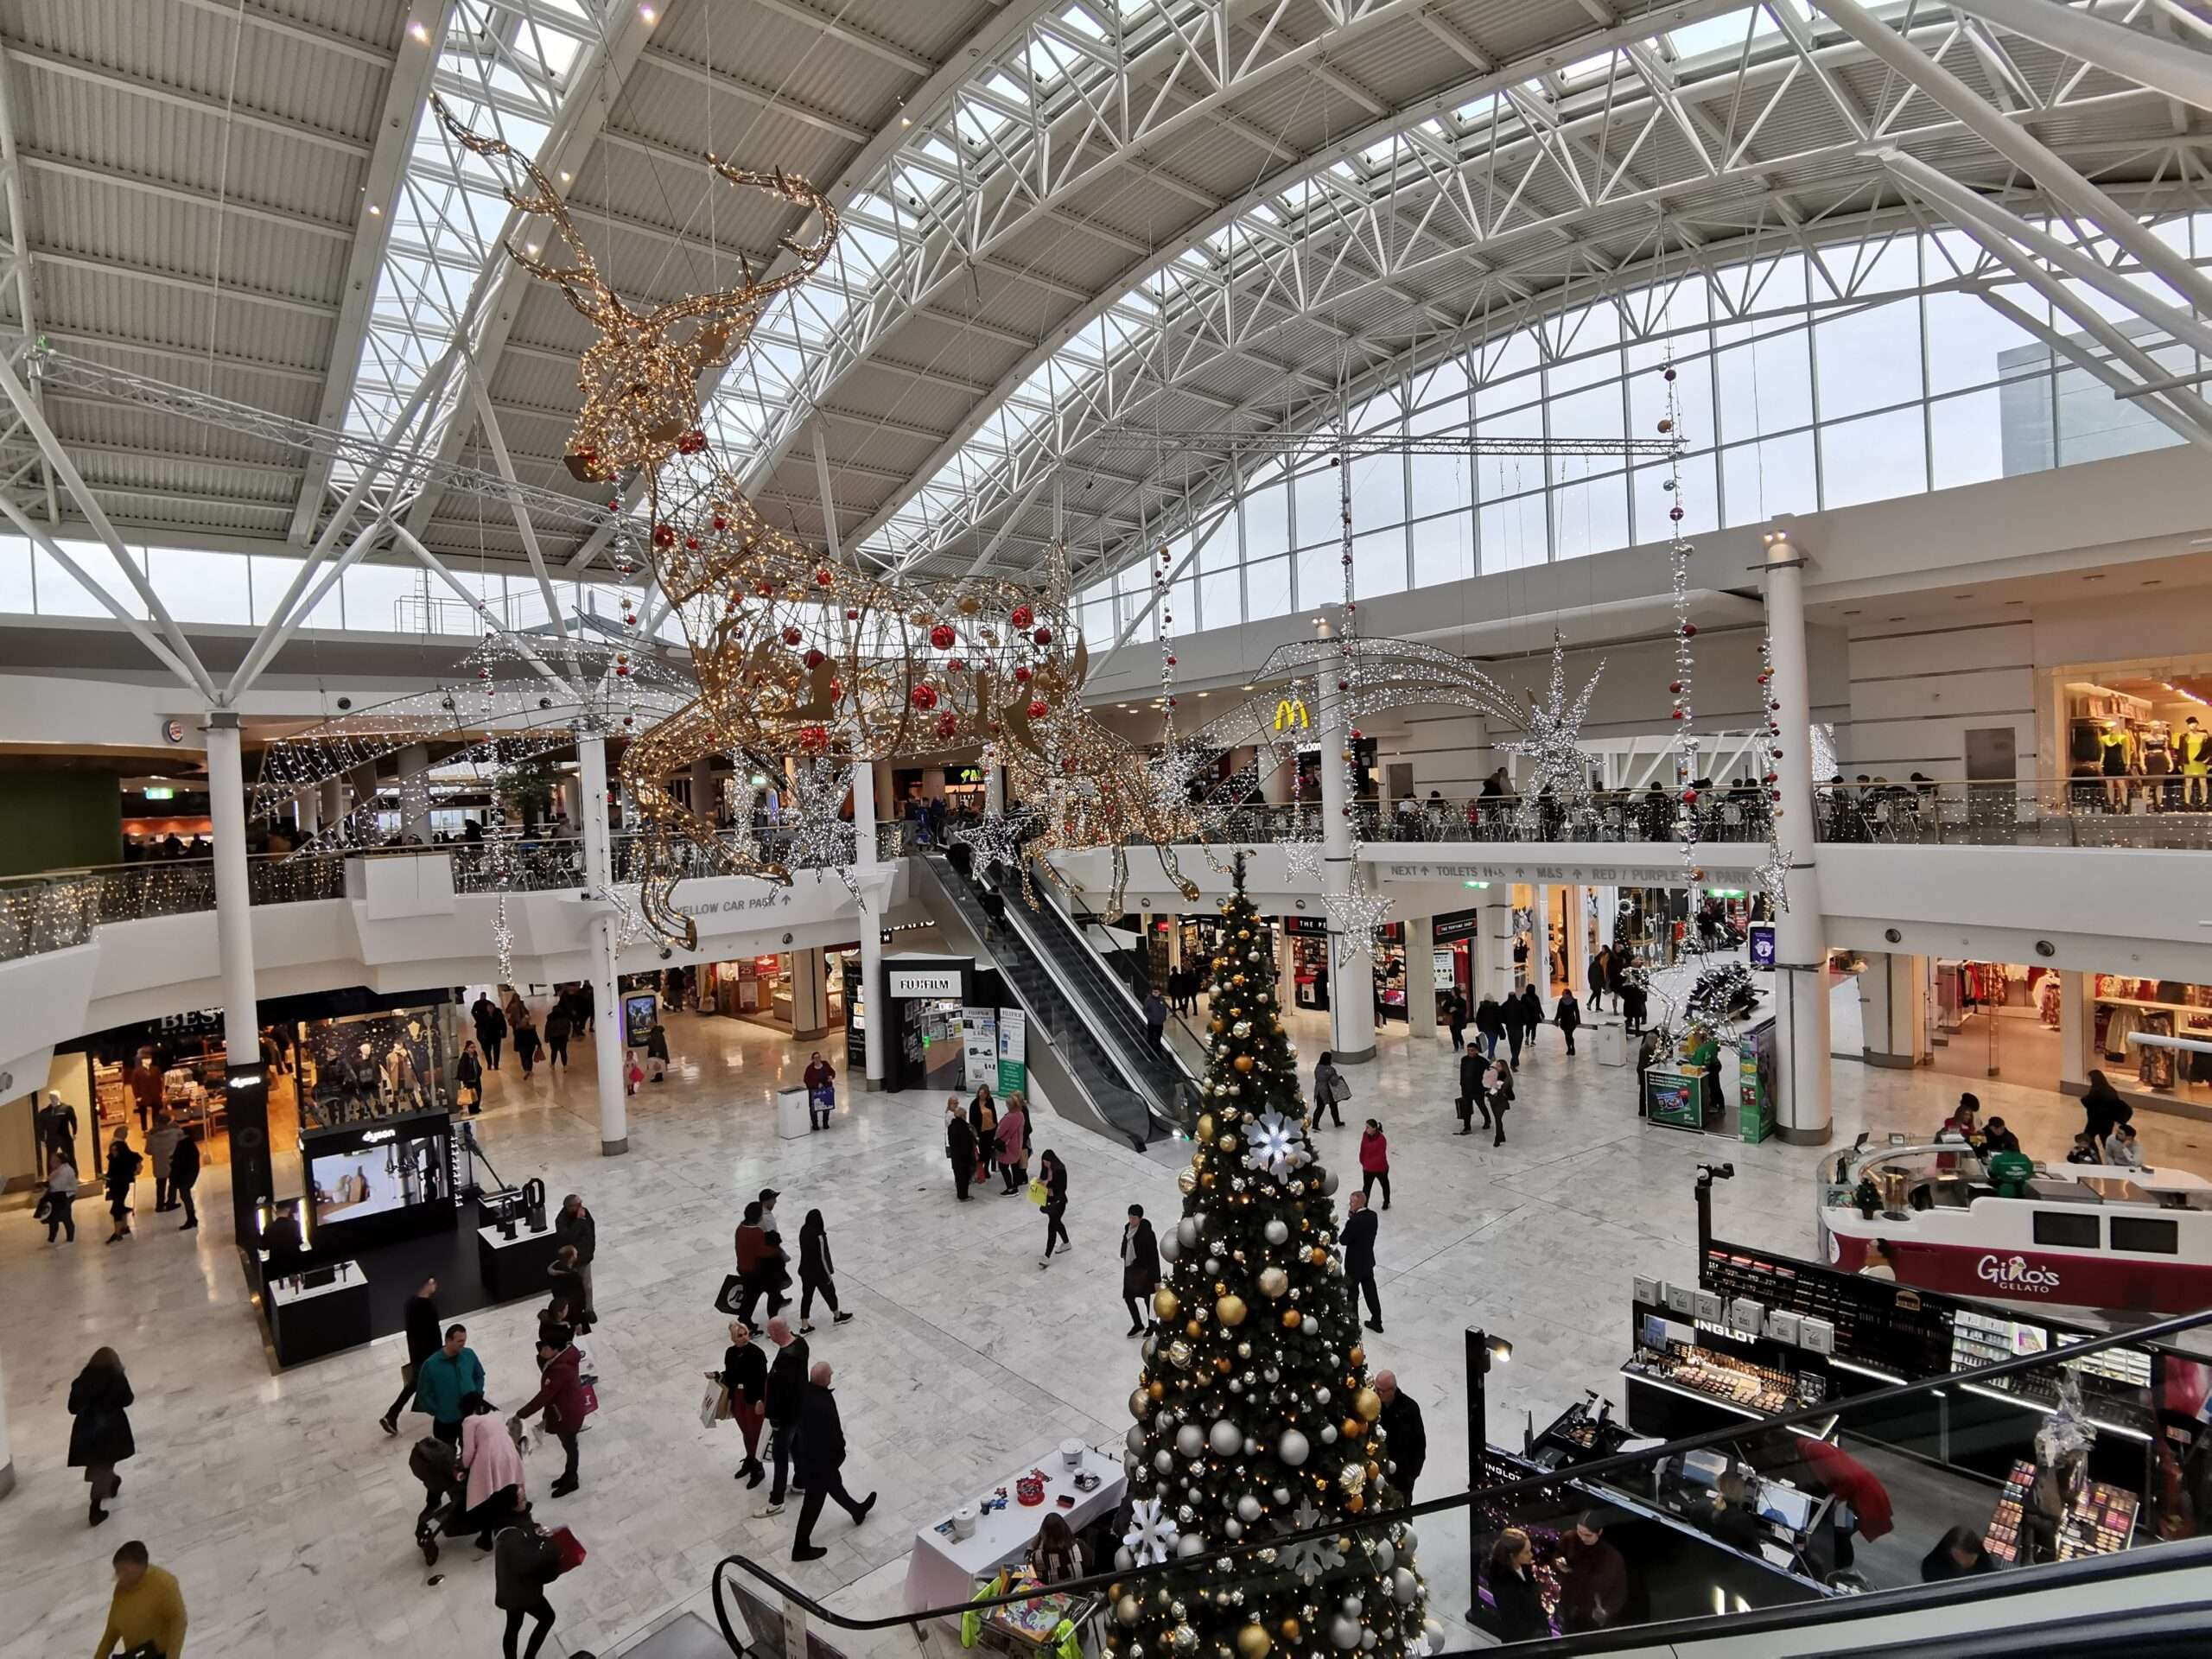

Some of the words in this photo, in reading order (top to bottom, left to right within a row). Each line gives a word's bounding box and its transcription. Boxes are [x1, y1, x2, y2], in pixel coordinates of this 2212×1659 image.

[1390, 866, 1417, 876] NEXT
[1436, 867, 1478, 877] TOILETS
[1535, 867, 1563, 879] M&S
[1592, 868, 1617, 880] RED
[1632, 869, 1679, 882] PURPLE
[1715, 870, 1751, 884] PARK
[675, 903, 719, 916] YELLOW
[722, 900, 745, 912] CAR
[900, 980, 949, 989] FUJIFILM
[161, 1008, 224, 1029] BES
[362, 1129, 396, 1143] dyson
[1977, 1254, 2060, 1286] Gino's
[1999, 1281, 2050, 1294] GELATO
[1693, 1318, 1759, 1344] INGLOT
[1485, 1462, 1522, 1481] INGLOT
